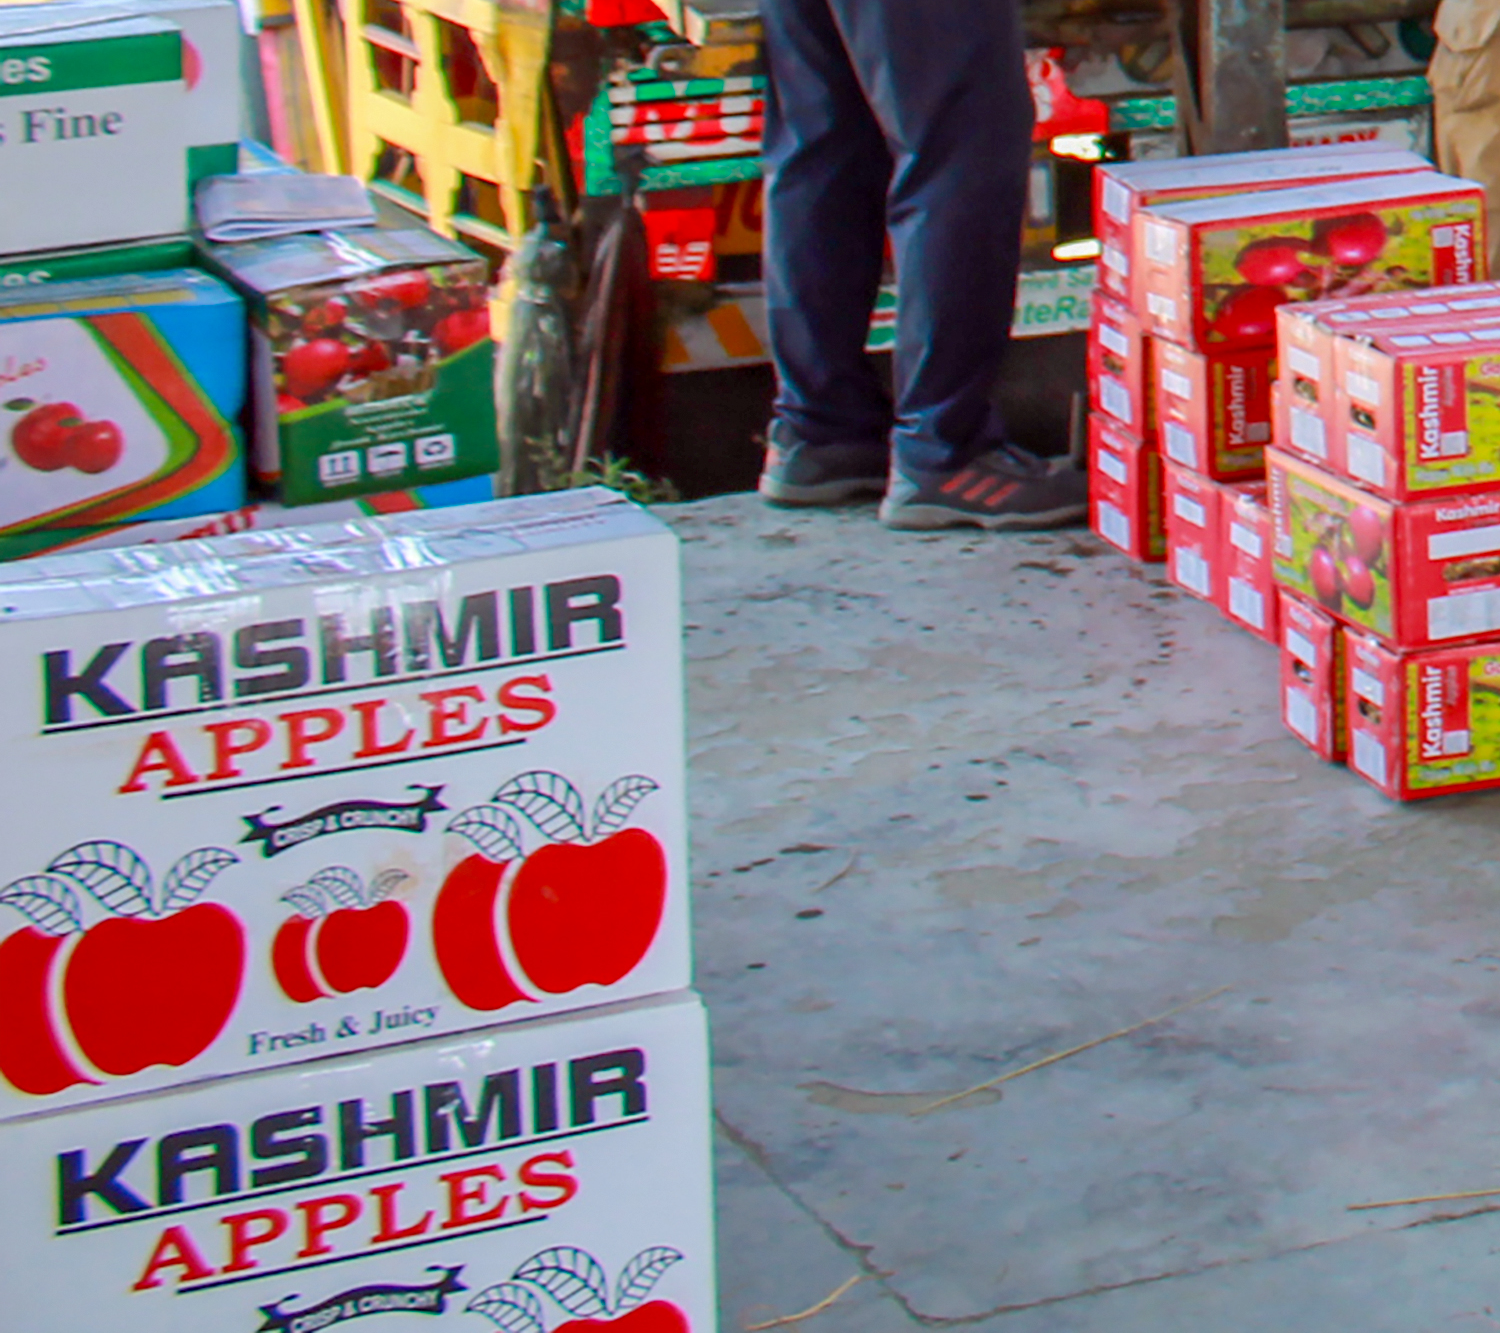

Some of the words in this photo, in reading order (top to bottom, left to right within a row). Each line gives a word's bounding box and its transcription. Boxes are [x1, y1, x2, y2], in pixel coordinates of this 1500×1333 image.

[20, 104, 125, 144] Fine
[1227, 363, 1246, 450] Kashmir
[1416, 364, 1440, 462] Kashmir
[1435, 498, 1500, 524] Kashmir
[41, 574, 626, 726] KASHMIR
[117, 673, 560, 796] APPLES
[1419, 664, 1442, 761] Kashmir
[247, 1023, 326, 1055] Fresh
[336, 1016, 360, 1038] &
[368, 1006, 440, 1034] Juicy
[56, 1046, 649, 1228] KASHMIR
[131, 1150, 582, 1293] APPLES
